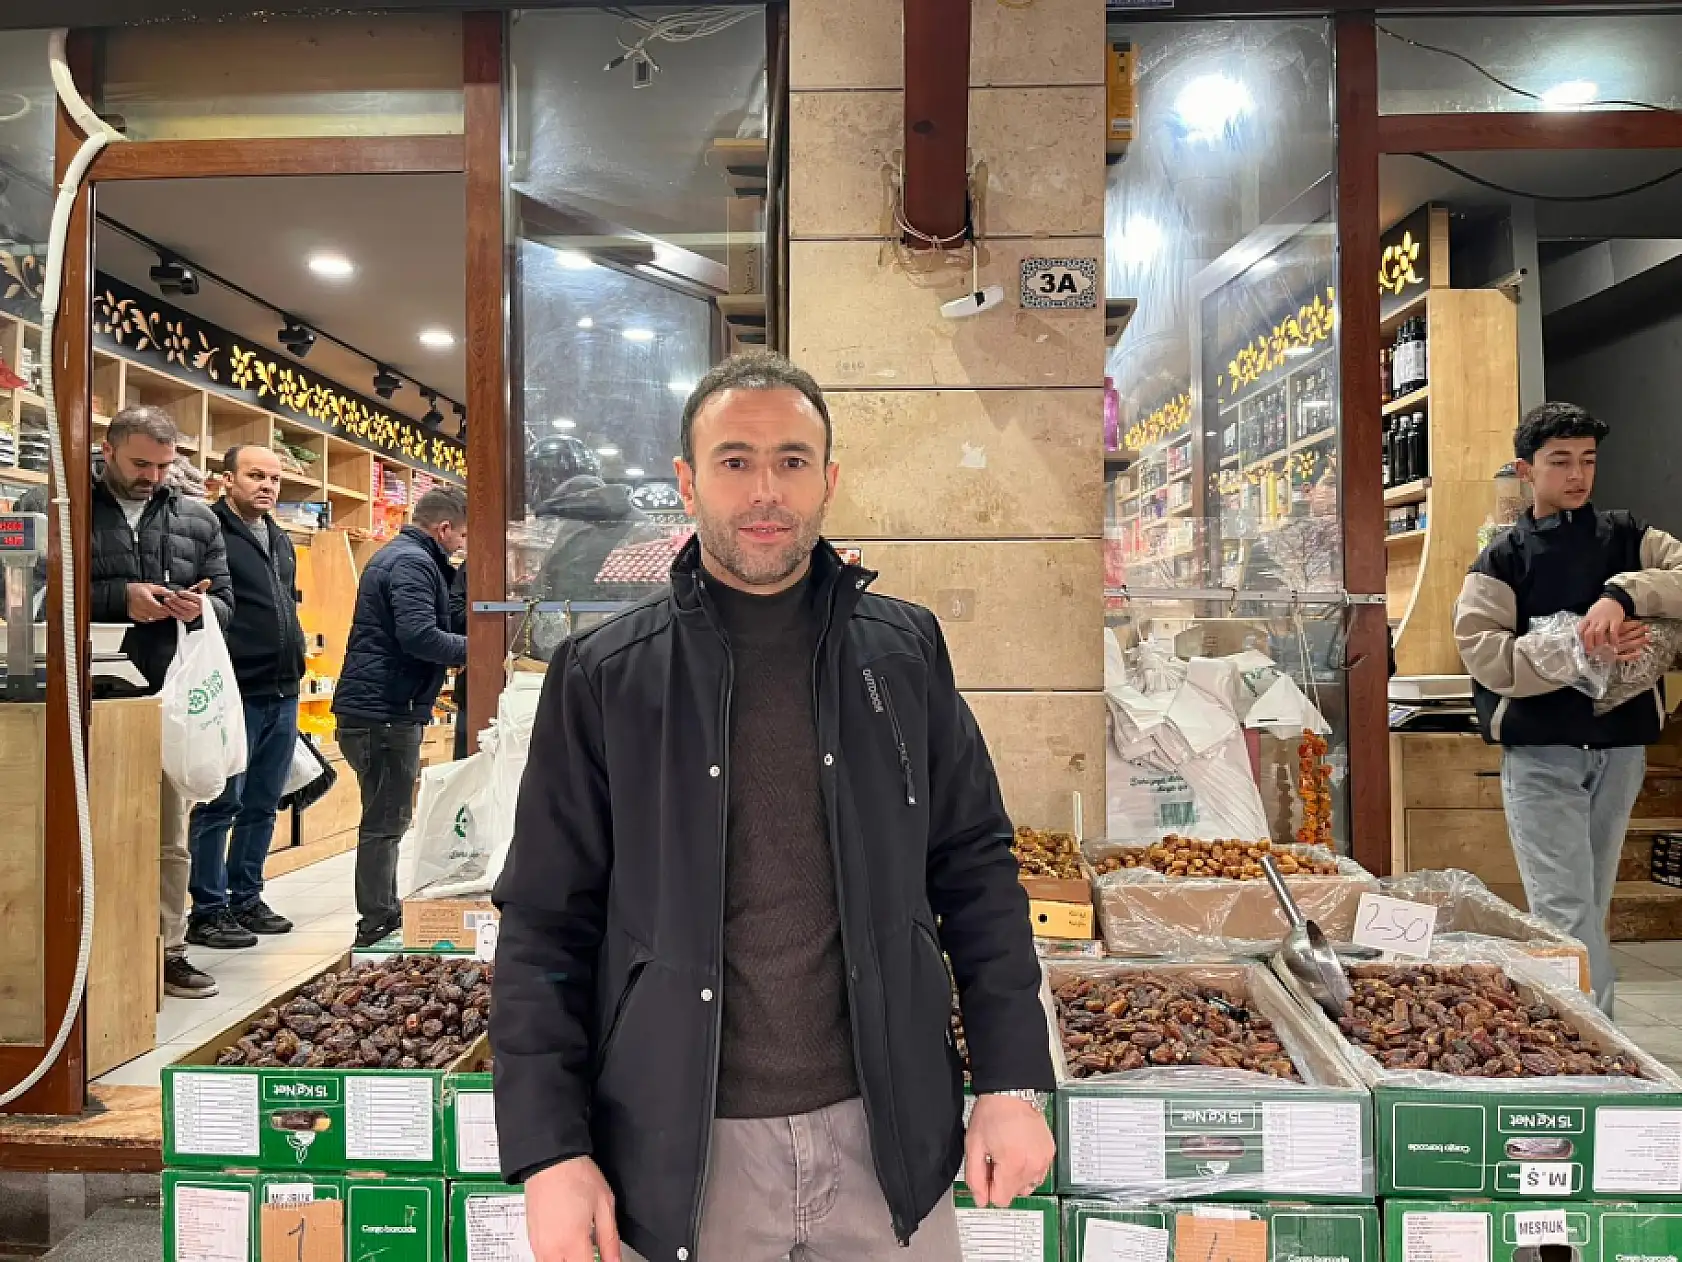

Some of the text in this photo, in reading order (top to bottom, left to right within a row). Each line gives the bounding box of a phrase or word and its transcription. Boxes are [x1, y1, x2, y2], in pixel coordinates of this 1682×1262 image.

[1039, 273, 1078, 293] 3A
[862, 668, 884, 713] OUTDOOR
[1364, 902, 1429, 943] 250
[273, 1083, 295, 1097] Net
[314, 1084, 328, 1097] 15
[1181, 1110, 1206, 1123] Net
[1229, 1110, 1244, 1124] 15
[1509, 1114, 1535, 1128] Net
[1558, 1114, 1573, 1128] 15
